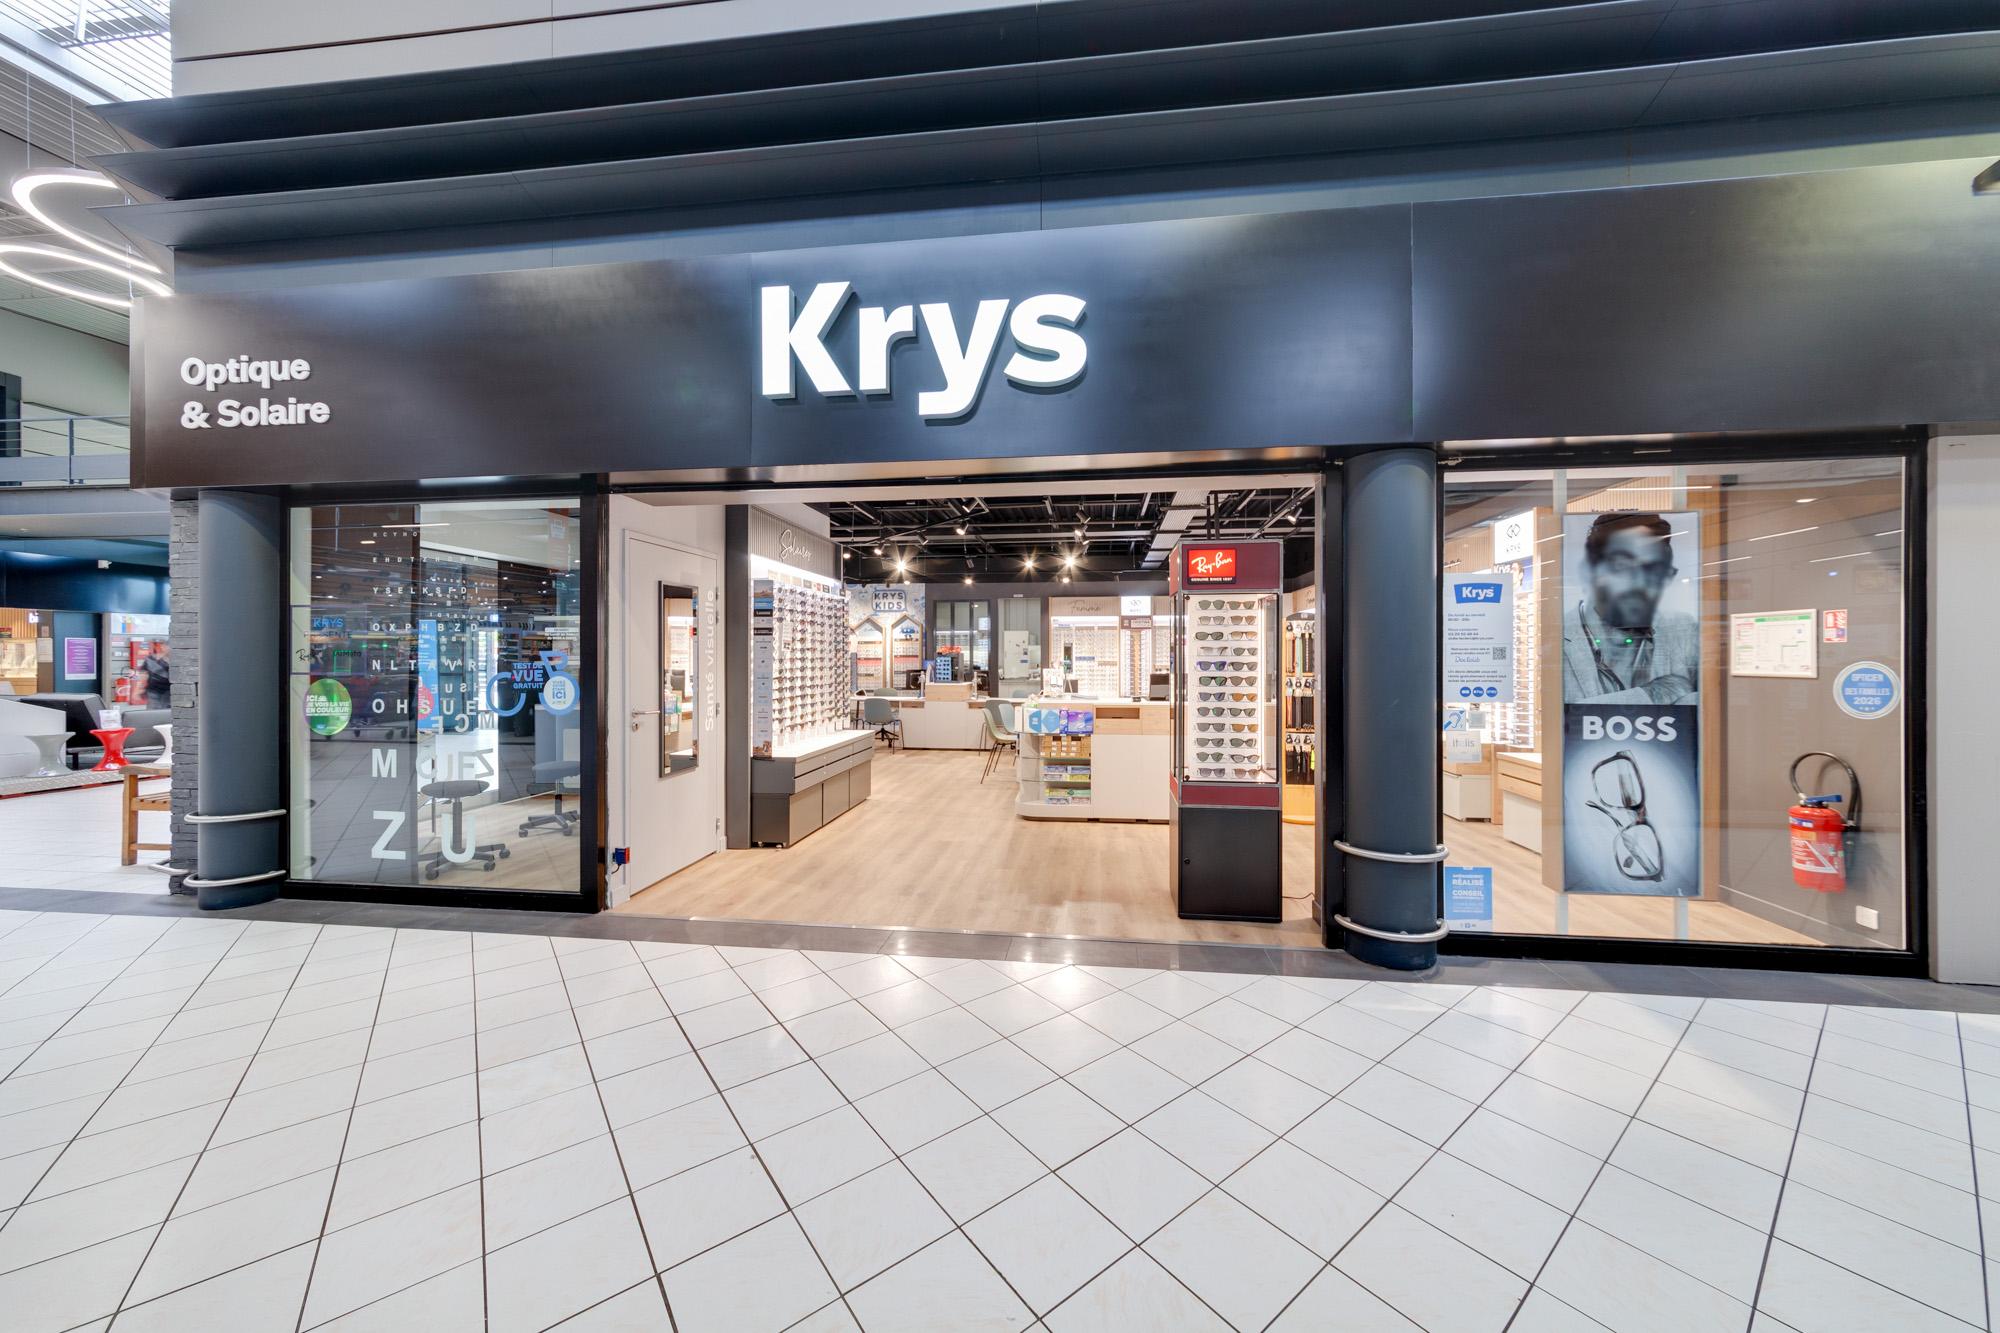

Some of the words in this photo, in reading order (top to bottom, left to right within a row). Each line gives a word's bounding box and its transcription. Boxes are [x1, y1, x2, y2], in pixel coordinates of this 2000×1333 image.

[761, 281, 1088, 418] Krys
[180, 354, 311, 392] Optique
[180, 400, 212, 429] &
[217, 397, 331, 428] Solaire
[1191, 551, 1233, 574] Ray-Ban
[874, 592, 904, 600] KRYS
[875, 602, 903, 610] KIDS
[1462, 586, 1495, 600] Krys
[704, 590, 714, 666] visuelle
[513, 669, 544, 682] VUE
[704, 671, 714, 731] Santé
[1582, 715, 1678, 742] BOSS
[371, 748, 397, 778] M
[371, 810, 406, 860] Z
[441, 812, 476, 864] U
[1452, 889, 1484, 897] CONSEIL
